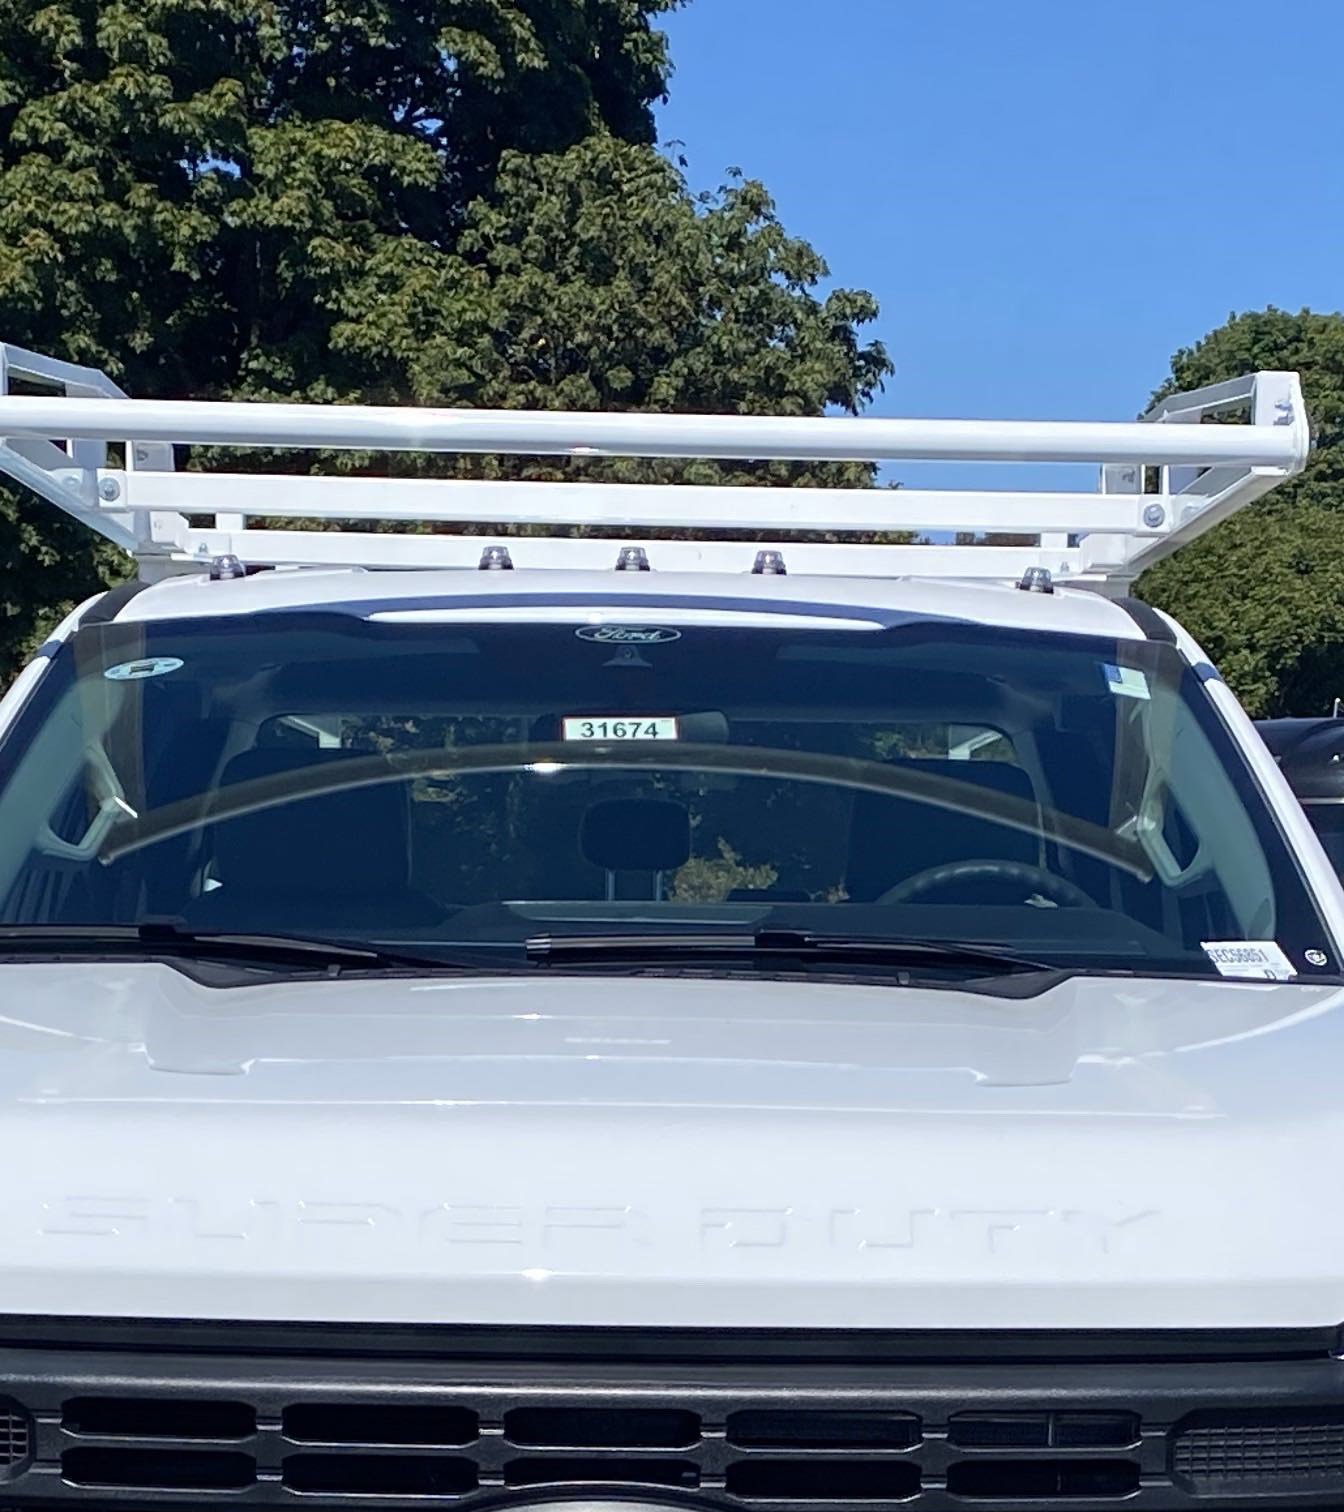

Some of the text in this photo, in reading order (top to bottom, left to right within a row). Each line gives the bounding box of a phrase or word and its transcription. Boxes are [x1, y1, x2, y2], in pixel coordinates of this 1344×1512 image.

[594, 627, 661, 640] Ford
[580, 722, 659, 739] 31674
[38, 1195, 1162, 1254] SUPER DUTY
